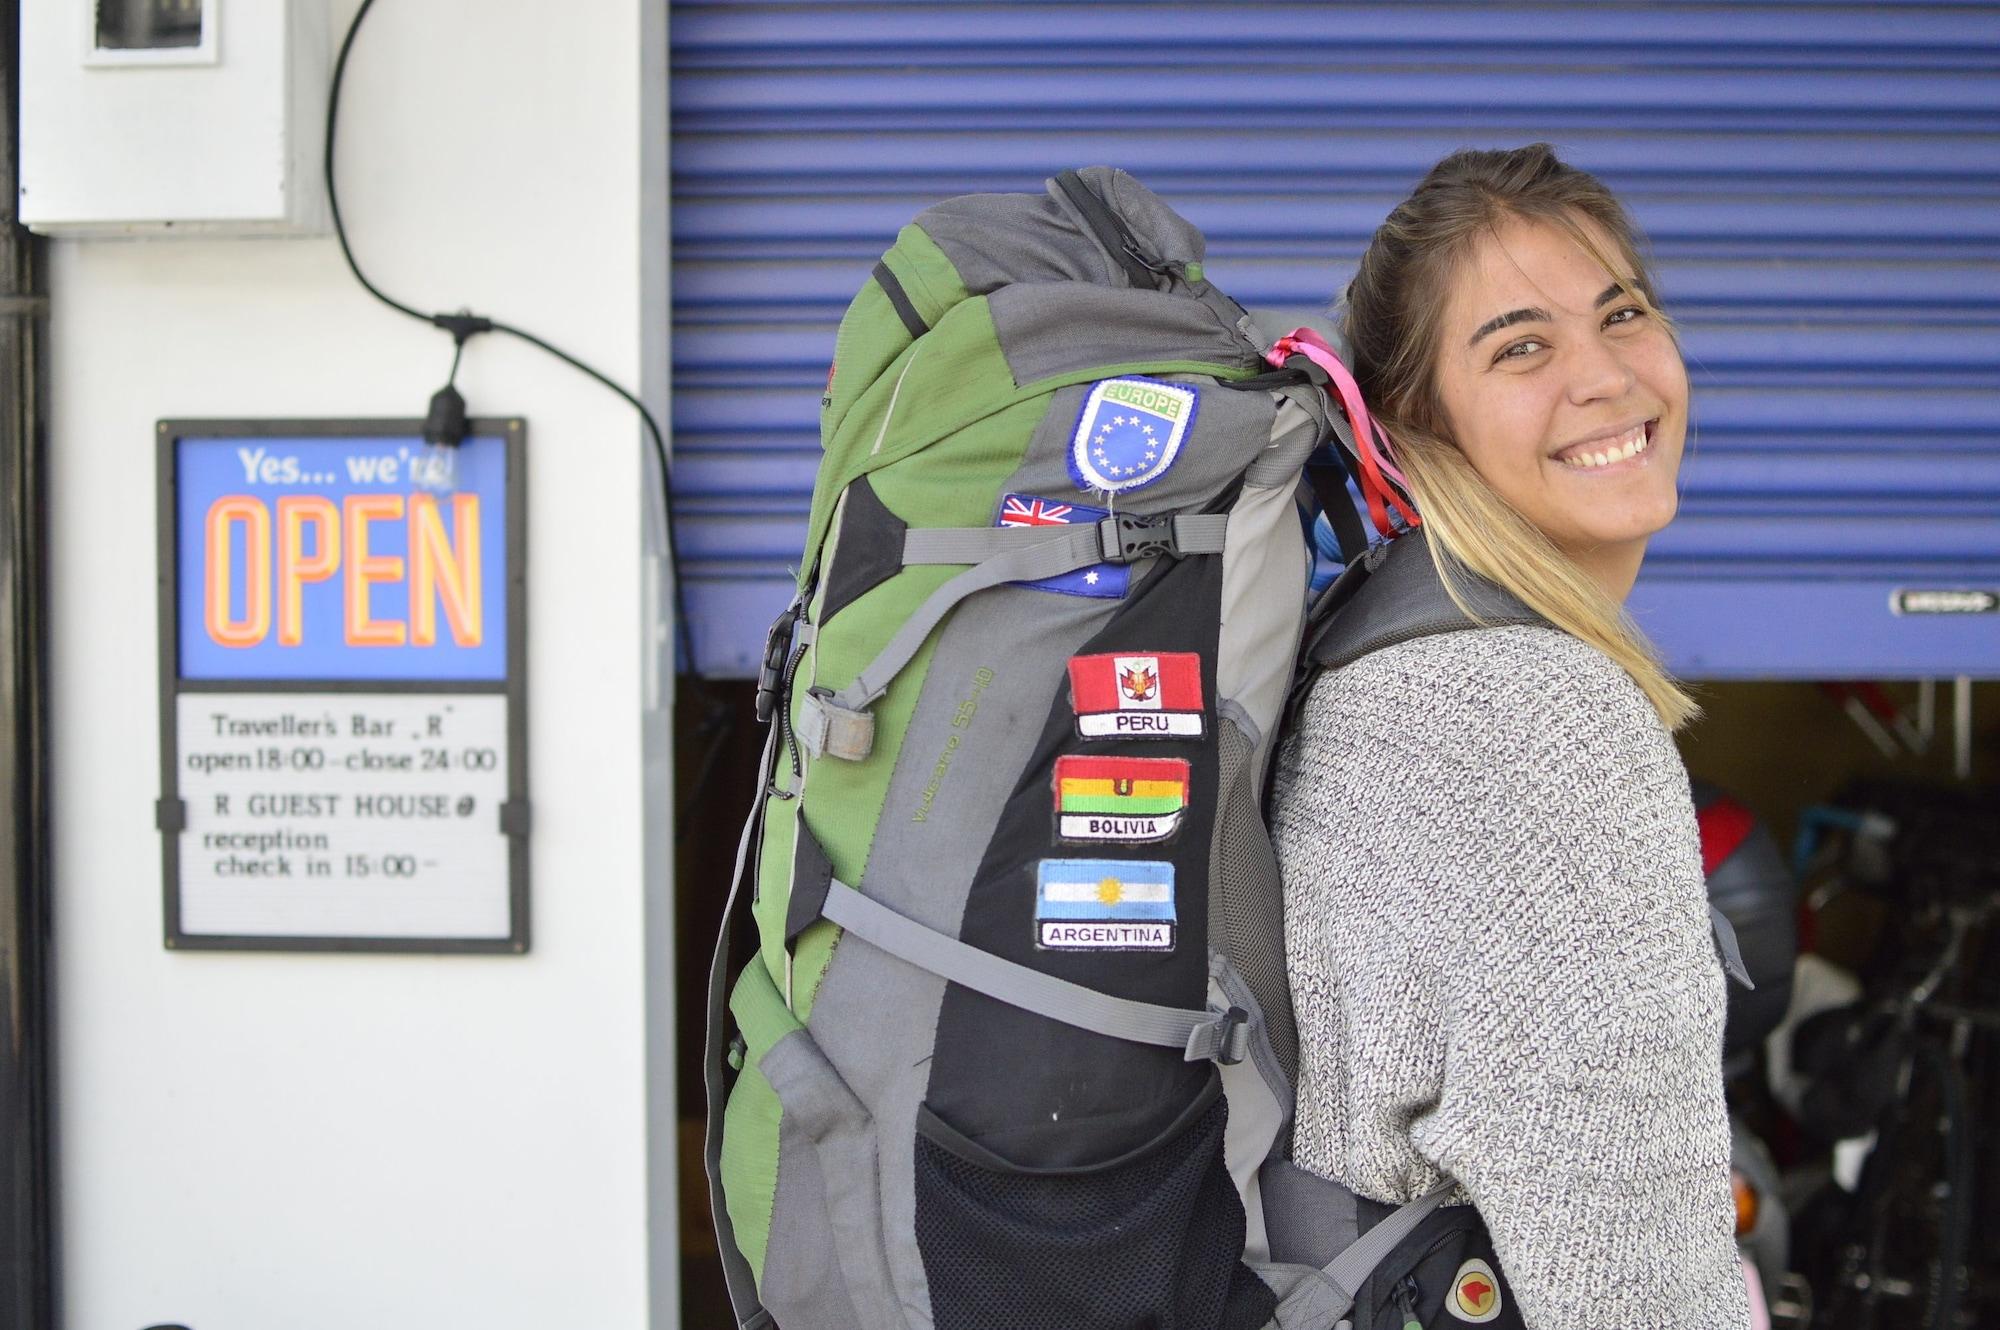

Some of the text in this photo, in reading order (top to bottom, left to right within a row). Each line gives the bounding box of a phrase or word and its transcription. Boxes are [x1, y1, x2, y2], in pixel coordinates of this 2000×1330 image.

[1103, 383, 1181, 417] EUROPE
[238, 447, 336, 484] Yes...
[204, 493, 483, 648] OPEN
[350, 714, 395, 737] Bar
[1116, 715, 1169, 731] PERU
[344, 748, 413, 771] close
[420, 748, 497, 771] 24:00
[213, 793, 231, 816] R
[246, 793, 341, 817] GUEST
[1089, 819, 1157, 835] BOLIVIA
[203, 828, 329, 854] reception
[214, 855, 292, 877] check
[306, 857, 332, 877] in
[346, 855, 417, 878] 15:00
[1049, 926, 1164, 943] ARGENTINA
